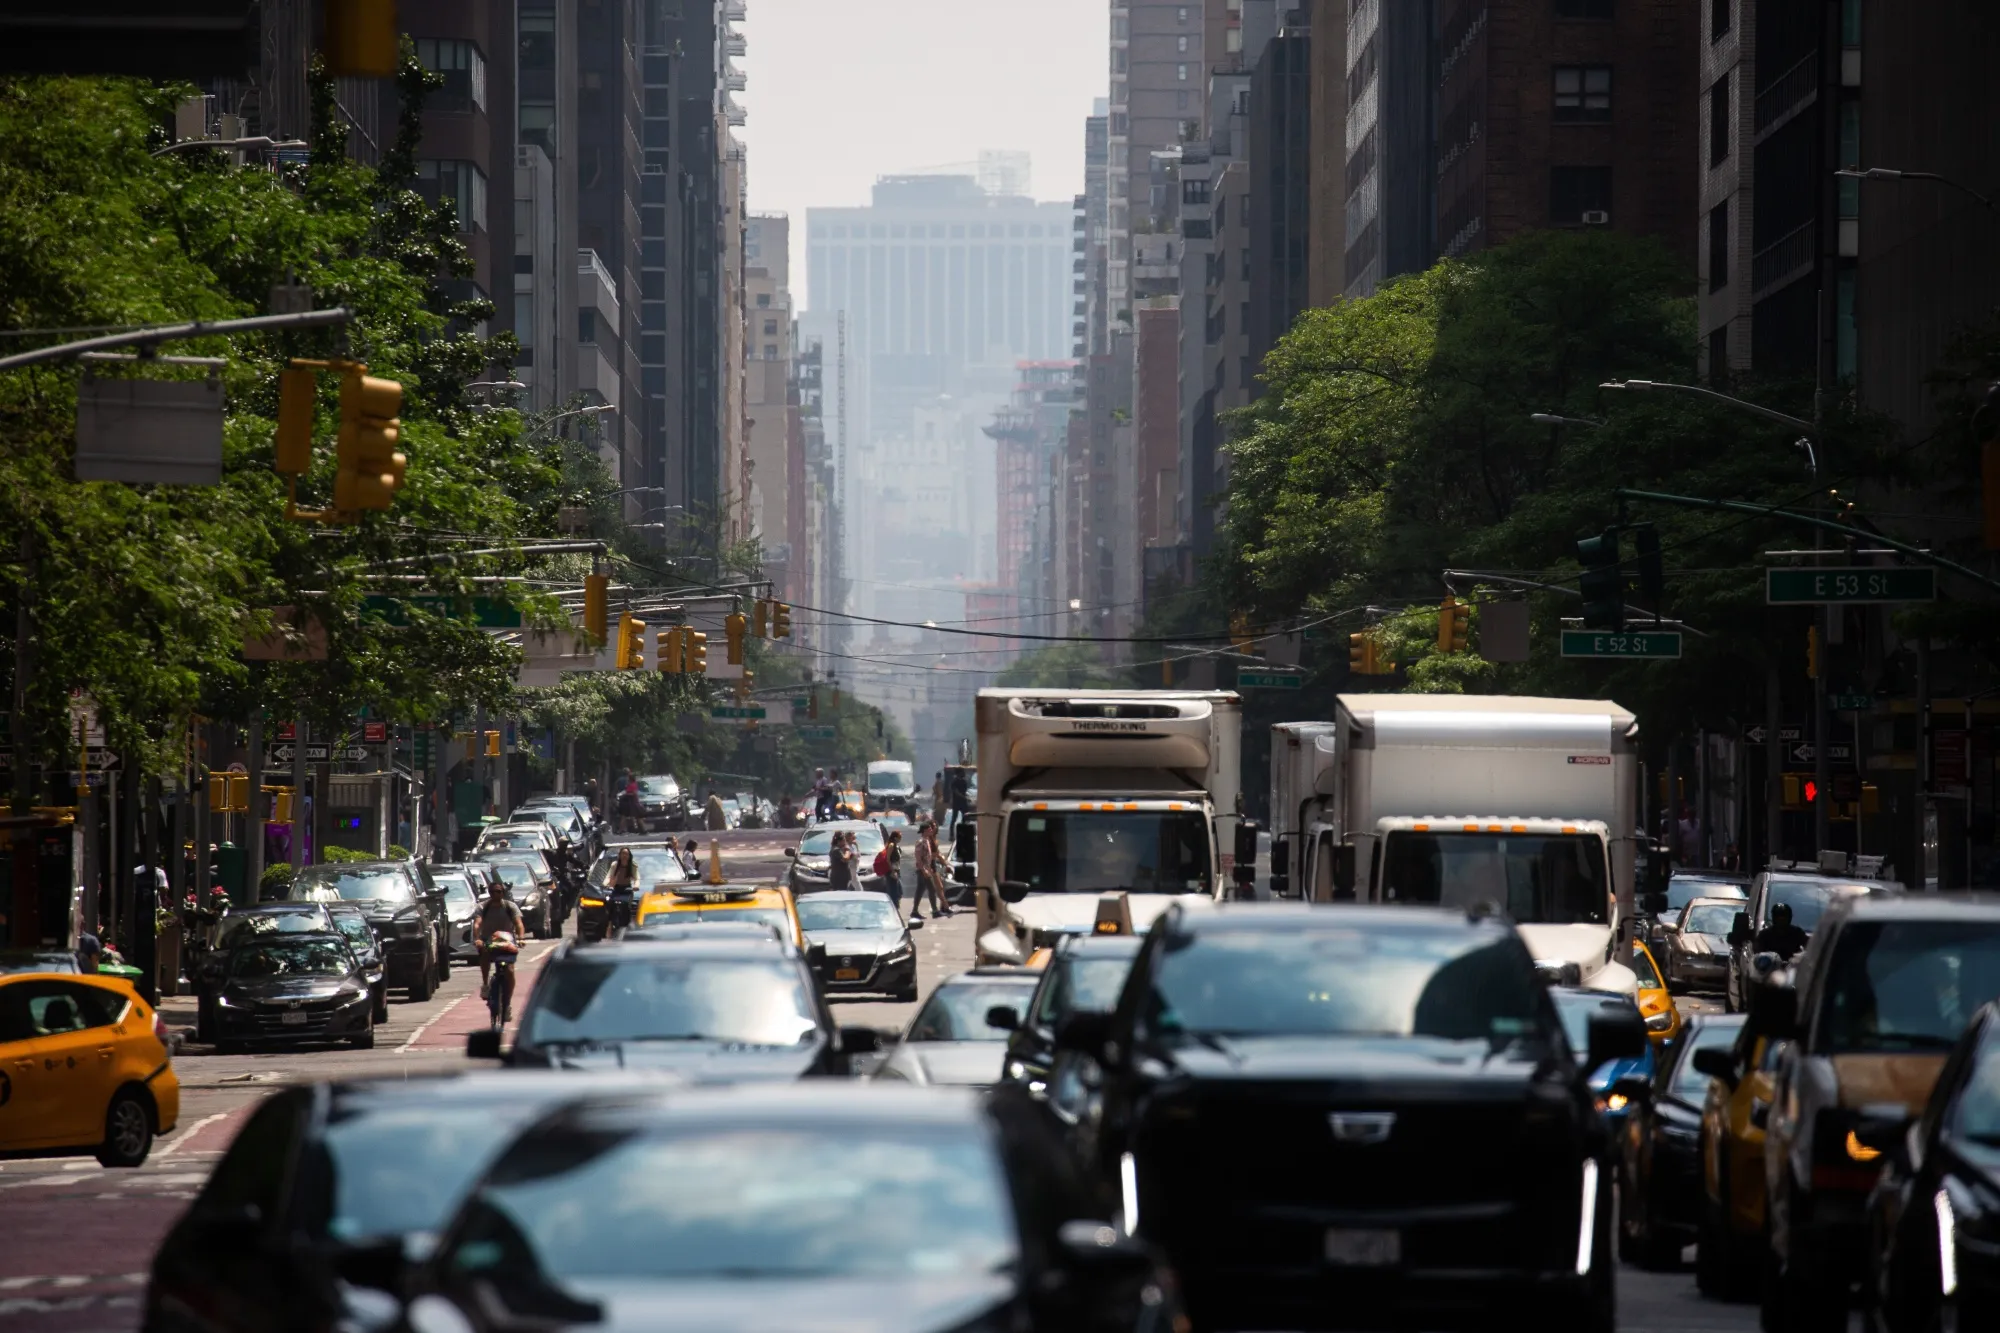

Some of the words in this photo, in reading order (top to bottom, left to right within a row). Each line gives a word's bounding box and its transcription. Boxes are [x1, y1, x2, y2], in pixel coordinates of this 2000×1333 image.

[1815, 576, 1826, 595] E
[1836, 575, 1859, 595] 53
[1869, 575, 1888, 594] St
[1594, 637, 1604, 651] E
[1610, 638, 1627, 652] 52
[1633, 638, 1648, 652] St
[1840, 696, 1847, 707] E
[1852, 695, 1868, 707] 52
[1071, 721, 1119, 731] THERMO
[1120, 721, 1147, 731] KING
